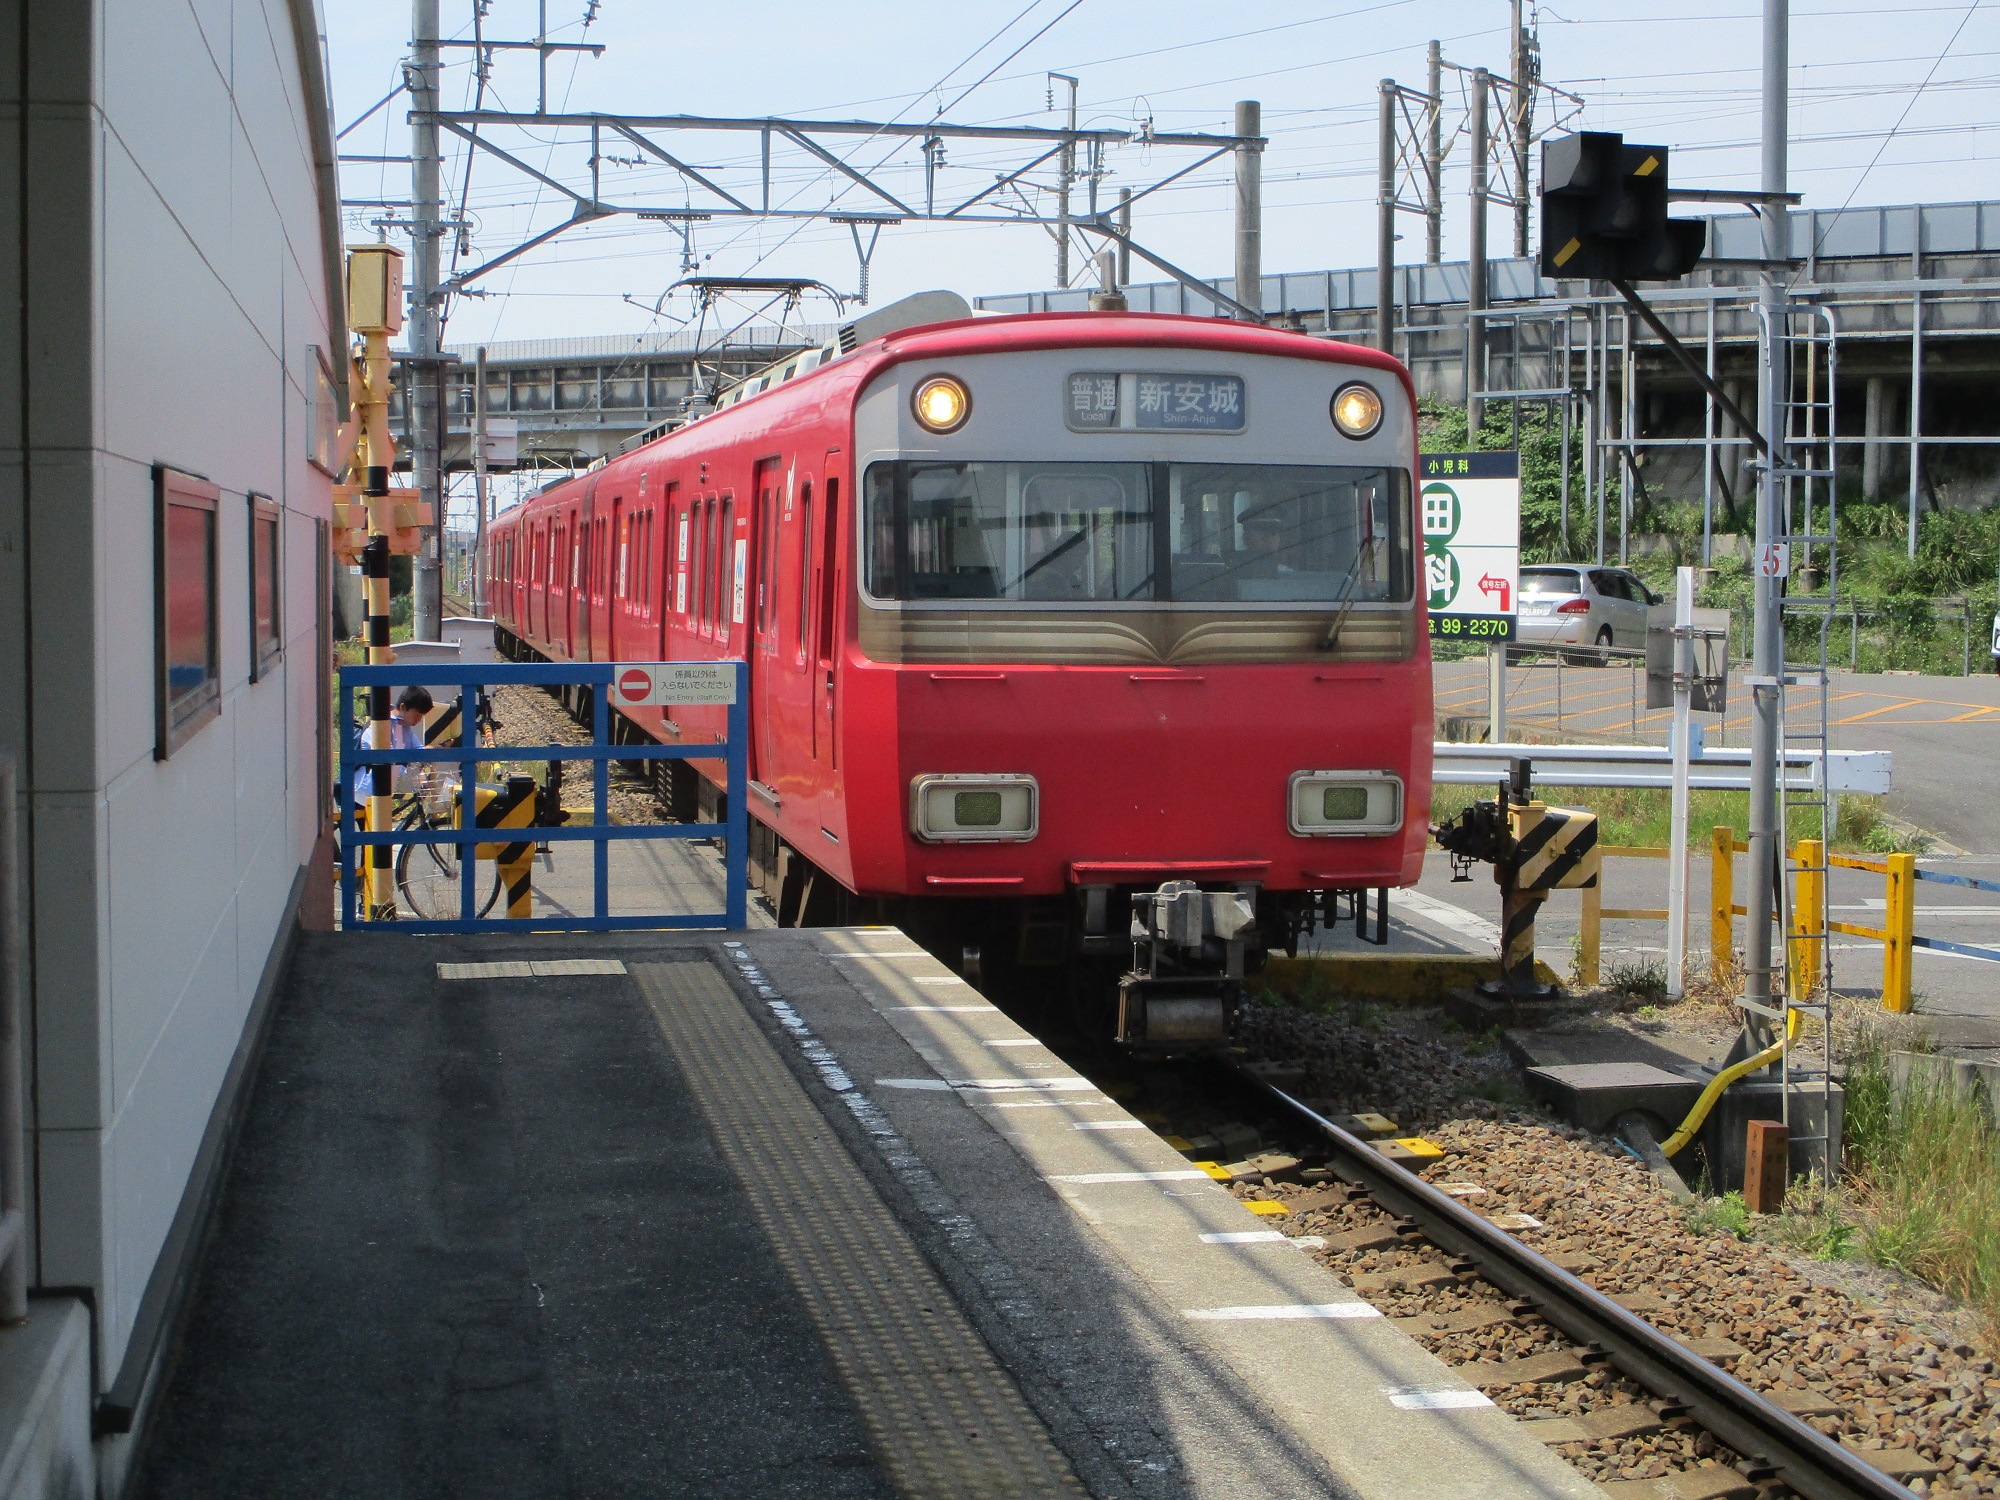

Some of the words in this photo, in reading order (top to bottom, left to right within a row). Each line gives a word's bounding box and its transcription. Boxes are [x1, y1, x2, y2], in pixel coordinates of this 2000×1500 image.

[1072, 378, 1116, 411] 普通
[1140, 381, 1239, 413] 新安城
[1081, 412, 1107, 421] Local
[1163, 413, 1216, 424] Shin-Anjo
[1428, 460, 1469, 473] 小児科
[1762, 545, 1780, 577] 5
[1441, 618, 1508, 636] 99-2370
[675, 670, 717, 679] 係員以外は
[661, 681, 732, 690] 入らないでください
[676, 694, 694, 702] Entry
[696, 694, 713, 702] (Staff
